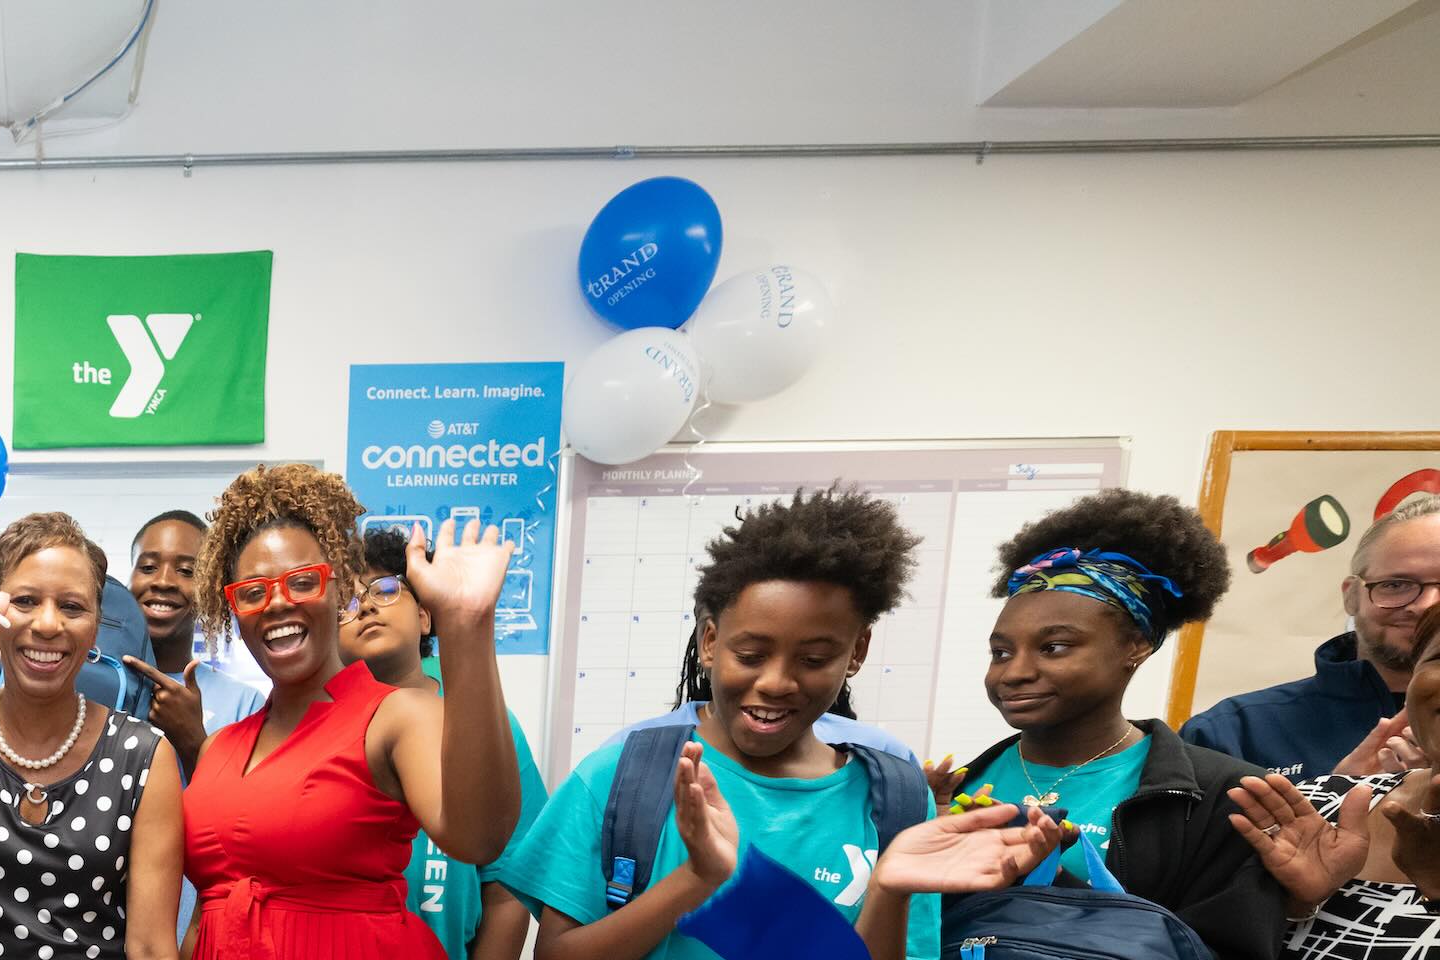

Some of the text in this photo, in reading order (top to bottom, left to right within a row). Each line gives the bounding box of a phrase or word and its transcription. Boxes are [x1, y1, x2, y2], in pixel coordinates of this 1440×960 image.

[592, 243, 658, 298] GRAND
[608, 268, 656, 306] OPENING
[771, 265, 794, 328] GRAND
[72, 361, 112, 385] the
[645, 345, 694, 397] GRAND
[145, 389, 167, 416] YMCA
[367, 383, 545, 402] Connect. Learn. Imagine.
[447, 422, 479, 436] AT&T
[362, 436, 545, 469] connected
[386, 473, 517, 487] LEARNING CENTER
[602, 470, 651, 481] MONTHLY
[814, 867, 841, 884] the
